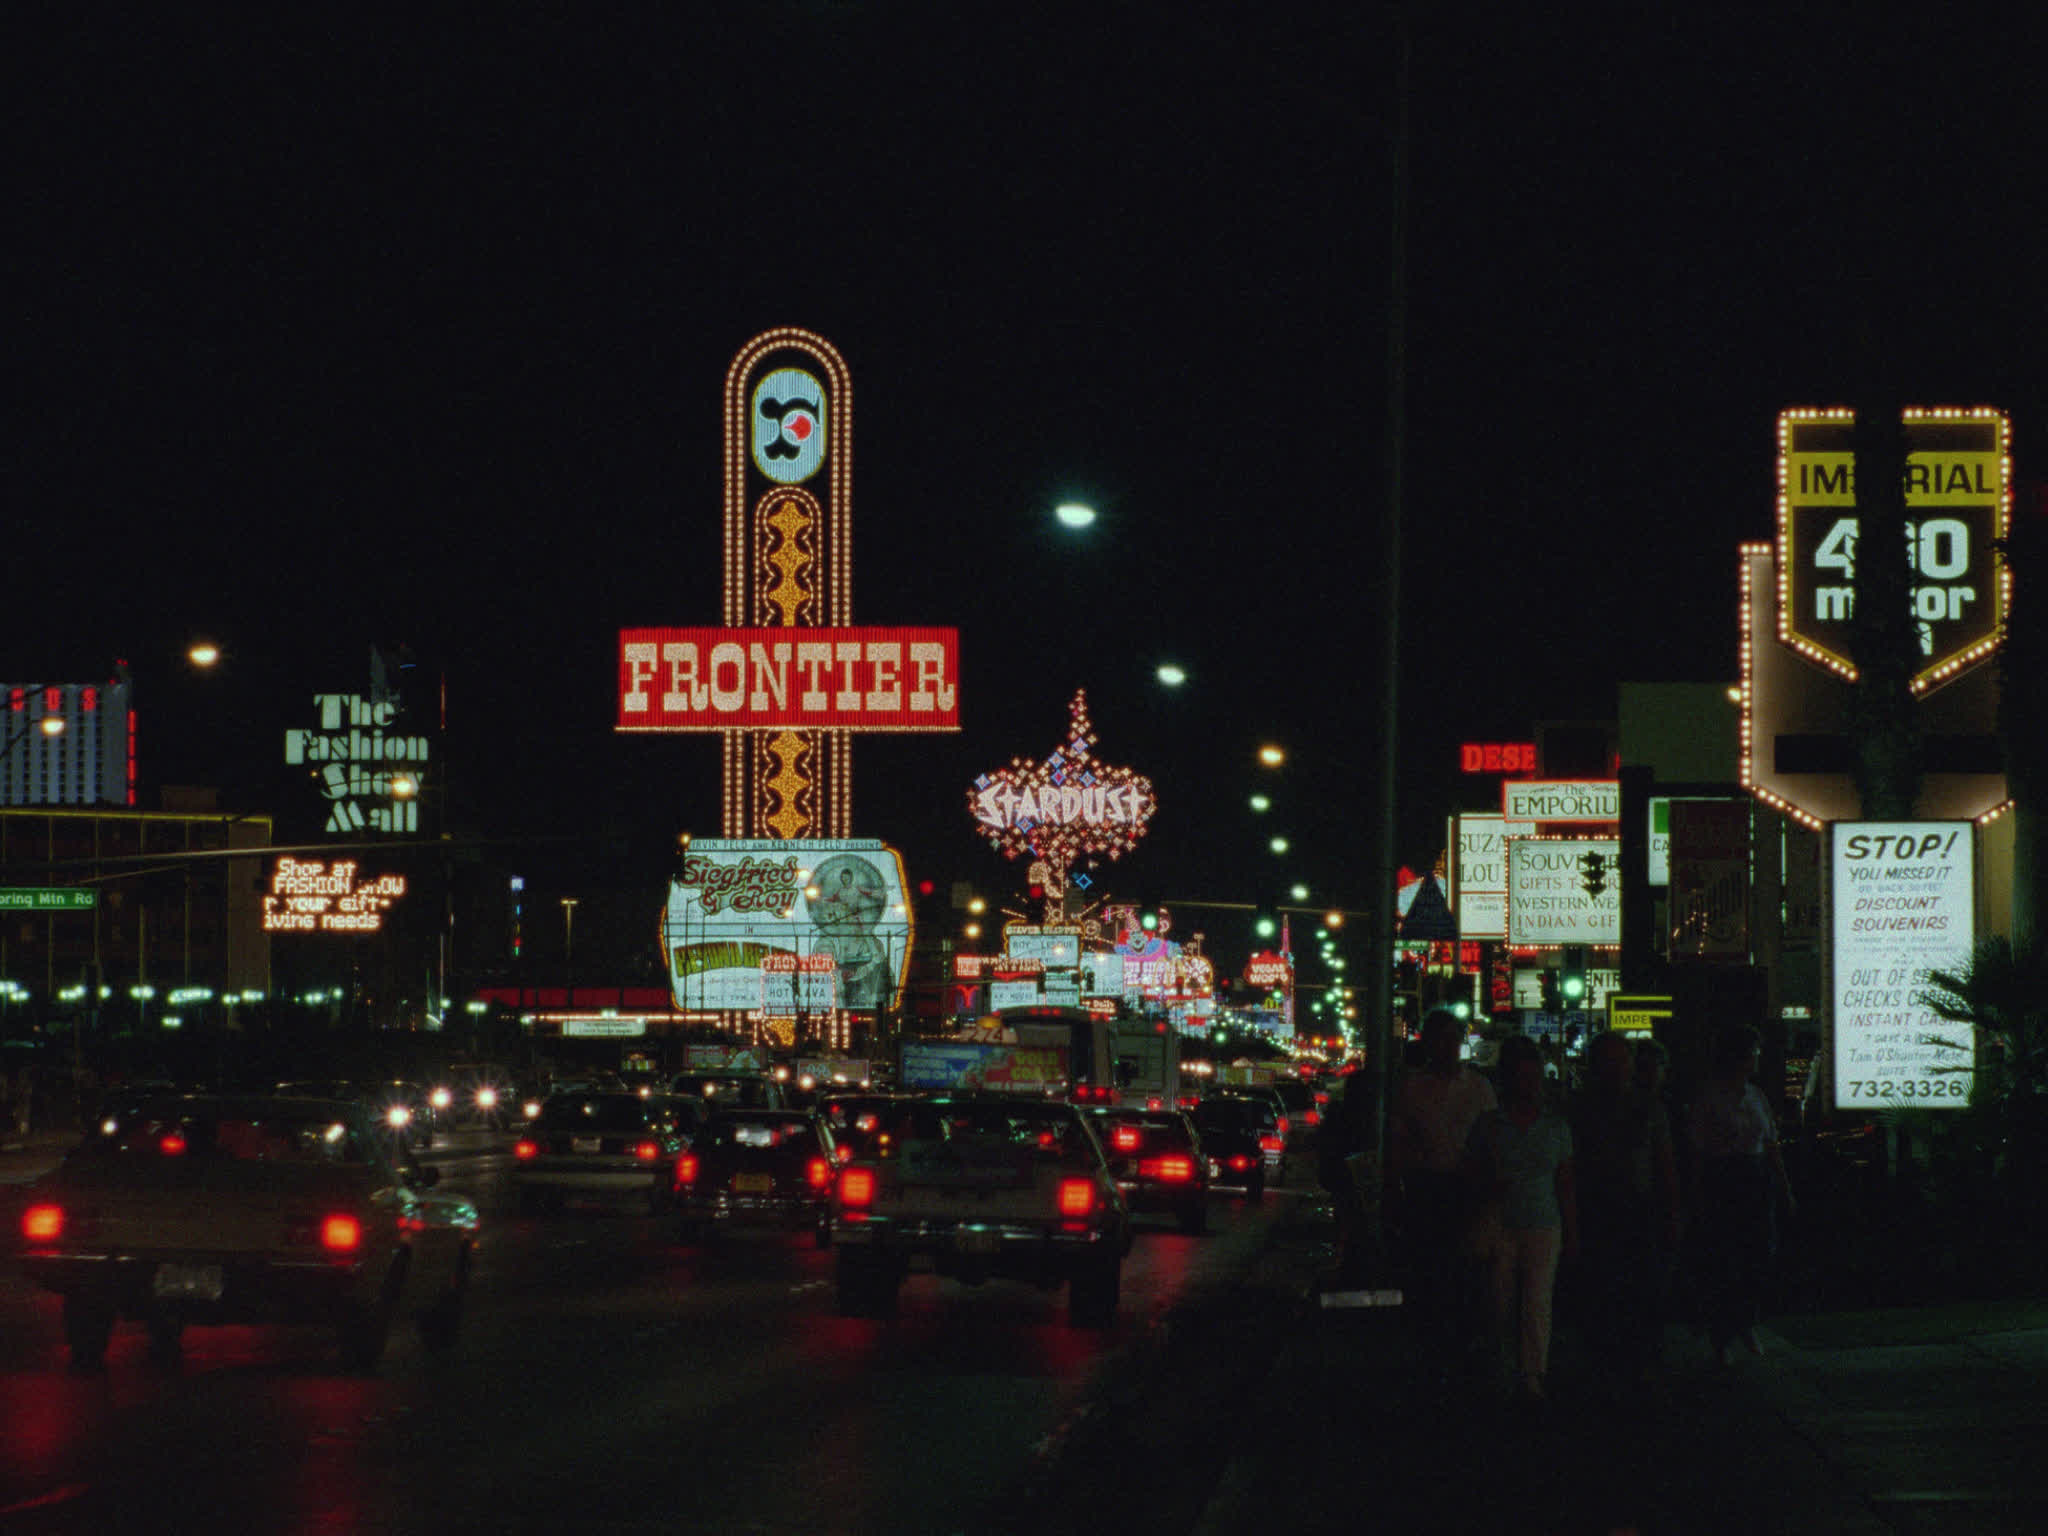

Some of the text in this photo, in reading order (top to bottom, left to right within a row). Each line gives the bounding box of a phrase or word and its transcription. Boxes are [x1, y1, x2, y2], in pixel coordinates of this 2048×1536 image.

[1800, 463, 1995, 494] IMRIAL
[1815, 519, 1969, 580] 40
[1816, 586, 1976, 621] mor
[623, 642, 955, 713] FRONTIER
[313, 694, 395, 730] The
[285, 729, 429, 765] Fashion
[1566, 784, 1585, 796] The
[977, 784, 1150, 829] STARDUST
[325, 801, 417, 833] Mall
[1845, 830, 1959, 861] STOP!
[278, 857, 356, 877] Shop at
[681, 856, 798, 890] Siegfried
[1850, 866, 1952, 882] YOU MISSED IT
[274, 876, 351, 894] FASHION
[1519, 876, 1563, 890] GIFTS
[39, 891, 65, 905] Mtn
[74, 892, 94, 905] Rd
[701, 885, 798, 918] & Roy
[1515, 896, 1589, 911] WESTERN
[1592, 896, 1619, 911] WE
[1855, 896, 1942, 912] DISCOUNT
[322, 911, 379, 929] needs
[1517, 914, 1577, 930] INDIAN
[1850, 915, 1949, 932] SOUVENIRS
[1850, 968, 1881, 987] OUT
[1887, 968, 1908, 986] OF
[1843, 990, 1902, 1008] CHECKS
[1849, 1012, 1912, 1027] INSTANT
